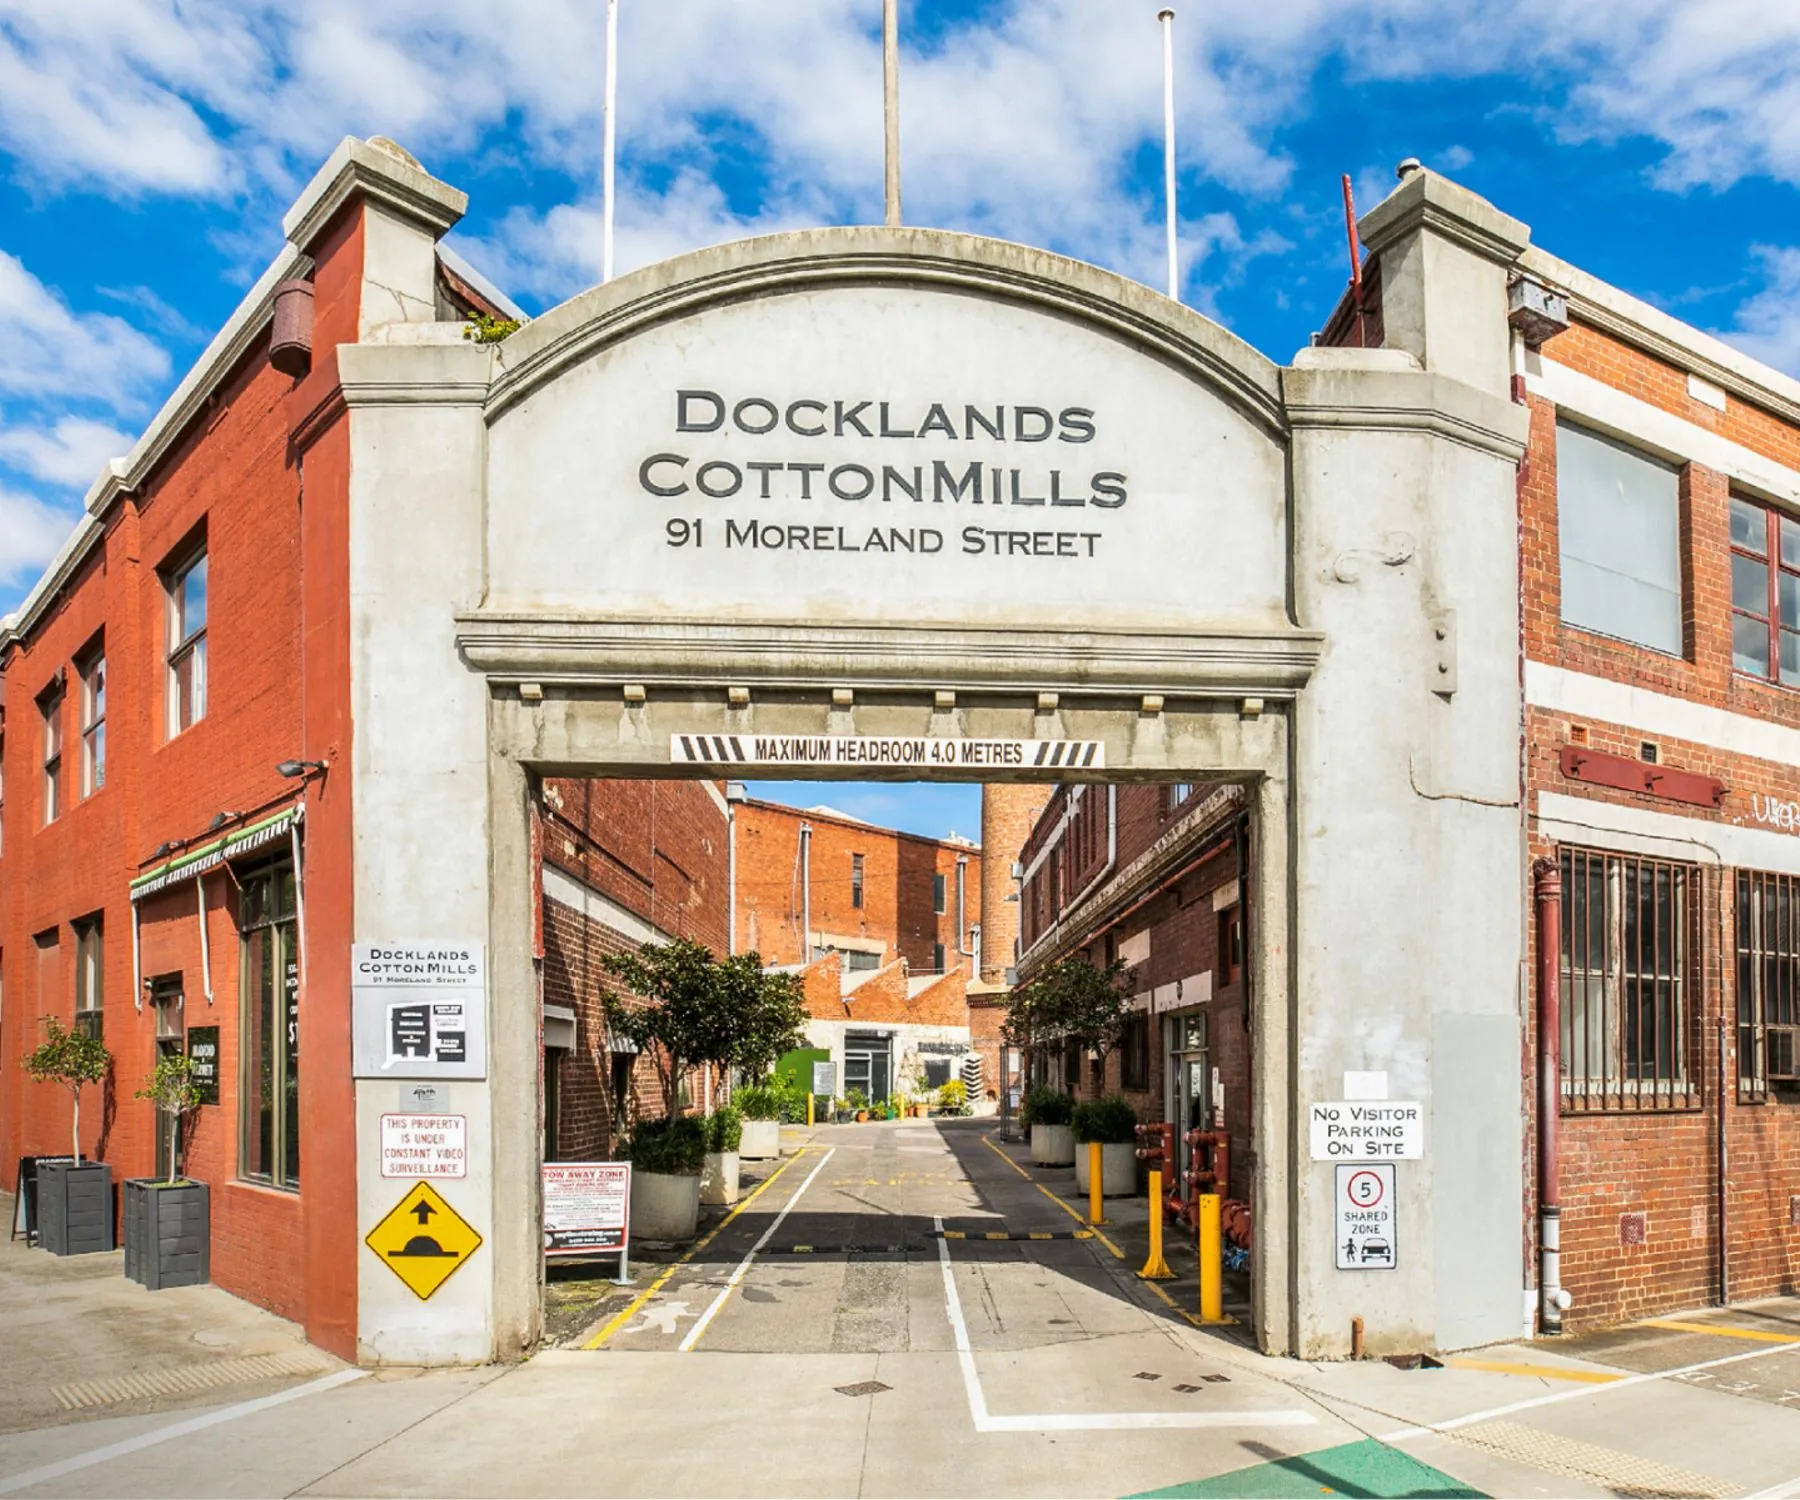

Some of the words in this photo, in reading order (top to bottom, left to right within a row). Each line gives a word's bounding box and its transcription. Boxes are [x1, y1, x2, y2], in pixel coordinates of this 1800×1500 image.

[675, 389, 1096, 443] DOCKLANDS
[665, 518, 703, 549] 91
[725, 519, 944, 553] MORELAND
[961, 526, 1102, 558] STREET
[755, 738, 831, 763] MAXIMUM
[836, 739, 926, 764] HEADROOM
[930, 741, 956, 764] 4.0
[961, 742, 1023, 765] METRES
[370, 949, 470, 960] DOCKLANDS
[1313, 1108, 1340, 1121] NO
[1350, 1107, 1417, 1121] VISITOR
[387, 1119, 407, 1129] THIS
[411, 1119, 460, 1129] PROPERTY
[1327, 1125, 1404, 1138] PARKING
[401, 1134, 410, 1144] IS
[414, 1134, 445, 1144] UNDER
[384, 1148, 431, 1159] CONSTANT
[436, 1149, 464, 1159] VIDEO
[1327, 1141, 1354, 1155] ON
[1366, 1141, 1405, 1155] SITE
[389, 1163, 458, 1174] SURVEILLANCE
[599, 1170, 624, 1178] ZONE
[1360, 1182, 1372, 1198] 5
[1344, 1211, 1388, 1222] SHARED
[1351, 1224, 1381, 1235] ZONE
